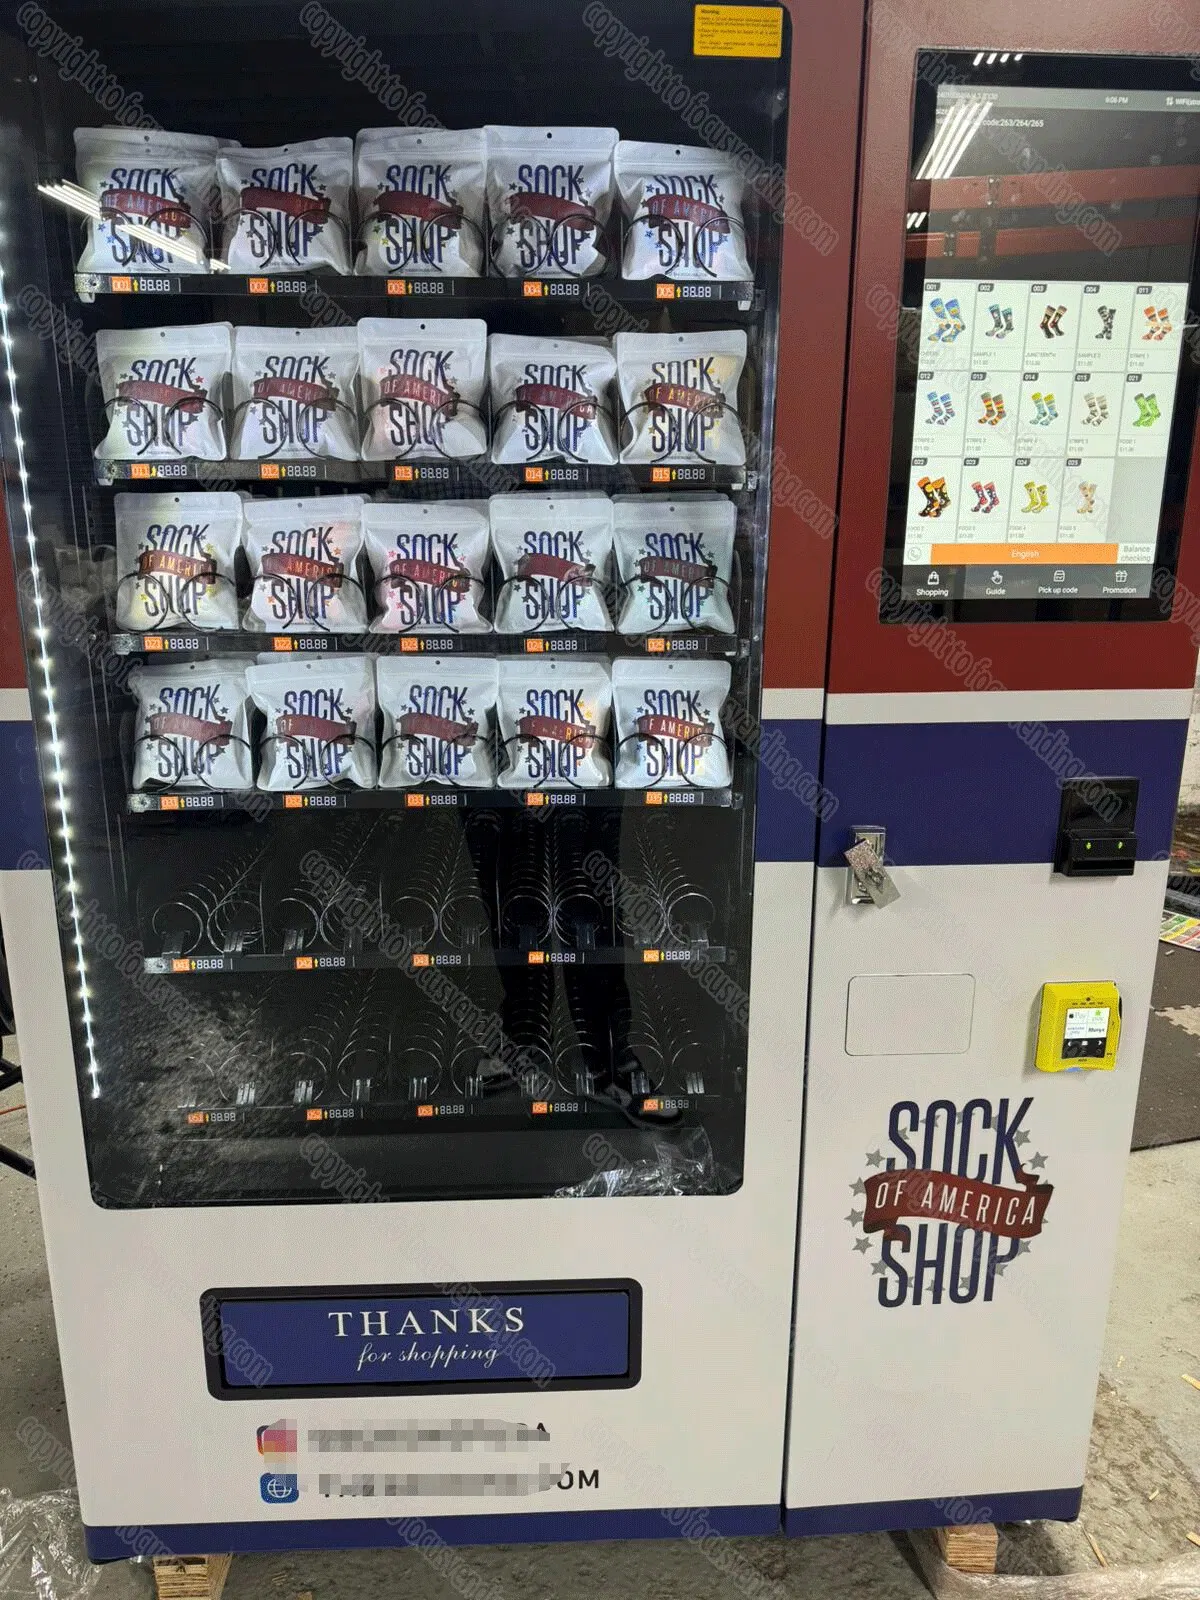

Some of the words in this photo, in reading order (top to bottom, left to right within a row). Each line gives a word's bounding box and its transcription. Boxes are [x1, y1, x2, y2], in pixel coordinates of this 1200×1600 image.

[108, 168, 181, 199] SOCK
[251, 163, 319, 196] SOCK
[386, 165, 452, 197] SOCK
[518, 165, 585, 199] SOCK
[653, 175, 715, 206] SOCK
[249, 211, 316, 258] SHOP
[386, 216, 451, 265] SHOP
[520, 218, 588, 268] SHOP
[658, 222, 723, 267] SHOP
[926, 283, 937, 291] 001
[979, 284, 990, 292] 002
[131, 357, 197, 389] SOCK
[265, 356, 330, 388] SOCK
[390, 349, 454, 387] SOCK
[524, 364, 590, 392] SOCK
[652, 357, 715, 388] SOCK
[125, 401, 193, 446] SHOP
[263, 400, 327, 444] SHOP
[390, 402, 448, 447] SHOP
[524, 407, 583, 451] SHOP
[652, 406, 714, 452] SHOP
[527, 468, 541, 479] 014
[653, 468, 668, 479] 015
[146, 524, 210, 555] SOCK
[270, 527, 333, 559] SOCK
[396, 533, 458, 566] SOCK
[524, 531, 583, 560] SOCK
[645, 533, 703, 562] SOCK
[1011, 550, 1039, 559] English
[1123, 545, 1150, 553] Balance
[1121, 554, 1151, 562] checking
[144, 574, 207, 616] SHOP
[271, 577, 335, 619] SHOP
[400, 578, 462, 624] SHOP
[525, 578, 586, 619] SHOP
[649, 582, 710, 621] SHOP
[916, 588, 949, 597] Shopping
[159, 684, 220, 718] SOCK
[284, 689, 342, 718] SOCK
[408, 686, 468, 719] SOCK
[526, 690, 584, 719] SOCK
[644, 690, 700, 720] SOCK
[158, 736, 218, 778] SHOP
[287, 739, 346, 779] SHOP
[408, 737, 466, 777] SHOP
[528, 740, 587, 778] SHOP
[647, 740, 702, 777] SHOP
[886, 1097, 1034, 1184] SOCK
[875, 1179, 907, 1209] OF
[921, 1185, 1035, 1226] AMERICA
[878, 1222, 1022, 1308] SHOP
[328, 1306, 525, 1337] THANKS
[357, 1342, 392, 1372] for
[398, 1343, 500, 1370] shopping
